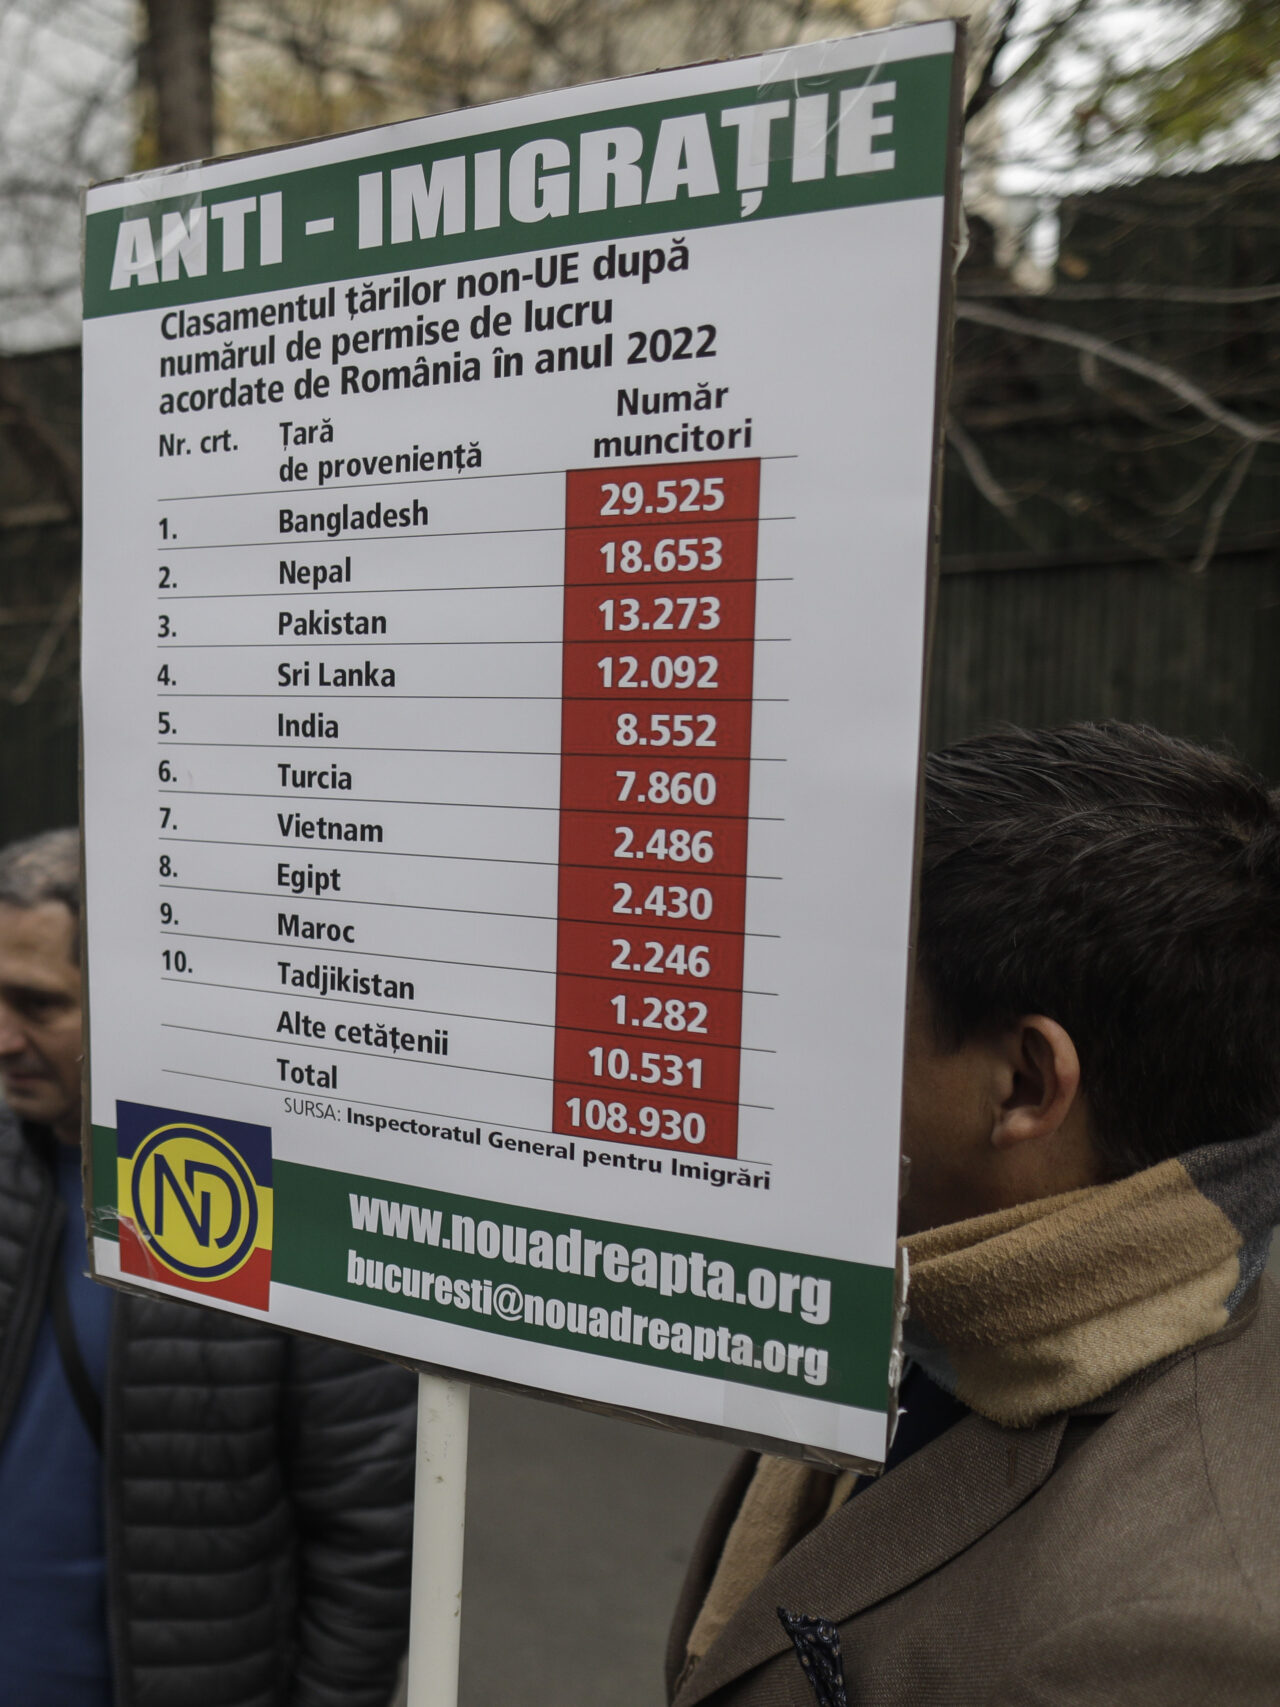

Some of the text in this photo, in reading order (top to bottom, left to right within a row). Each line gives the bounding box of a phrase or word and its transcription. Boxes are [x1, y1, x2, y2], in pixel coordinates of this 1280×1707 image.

[110, 81, 896, 290] ANTI - IMIGRAȚIE
[161, 236, 689, 340] Clasamentul țărilor non-UE după
[159, 324, 717, 415] acordate de România în anul 2022
[160, 299, 612, 378] numărul de permise de lucru
[617, 382, 729, 417] Număr
[159, 429, 238, 457] Nr. crt.
[279, 418, 334, 451] Țară
[279, 441, 482, 486] de proveniență
[593, 418, 752, 458] muncitori
[158, 477, 725, 540] 1. Bangladesh 29.525
[158, 537, 722, 590] 2. Nepal 18.653
[157, 596, 721, 638] 3. Pakistan 13.273
[157, 654, 719, 689] 4. Sri Lanka 12.092
[157, 712, 717, 747] 5. India 8.552
[158, 759, 716, 806] 6. Turcia 7.860
[158, 807, 714, 864] 7. Vietnam 2.486
[158, 855, 713, 921] 8. Egipt 2.430
[160, 902, 710, 979] 9. Maroc 2.246
[161, 949, 708, 1035] 10. Tadjikistan 1.282
[276, 1010, 704, 1090] Alte cetățenii 10.531
[276, 1057, 706, 1144] Total 108.930
[283, 1098, 771, 1190] SURSA: Inspectoratul General pentru Imigrări
[347, 1192, 831, 1326] www.nouadreapta.org
[346, 1249, 829, 1387] bucuresti@nouadreapta.org
